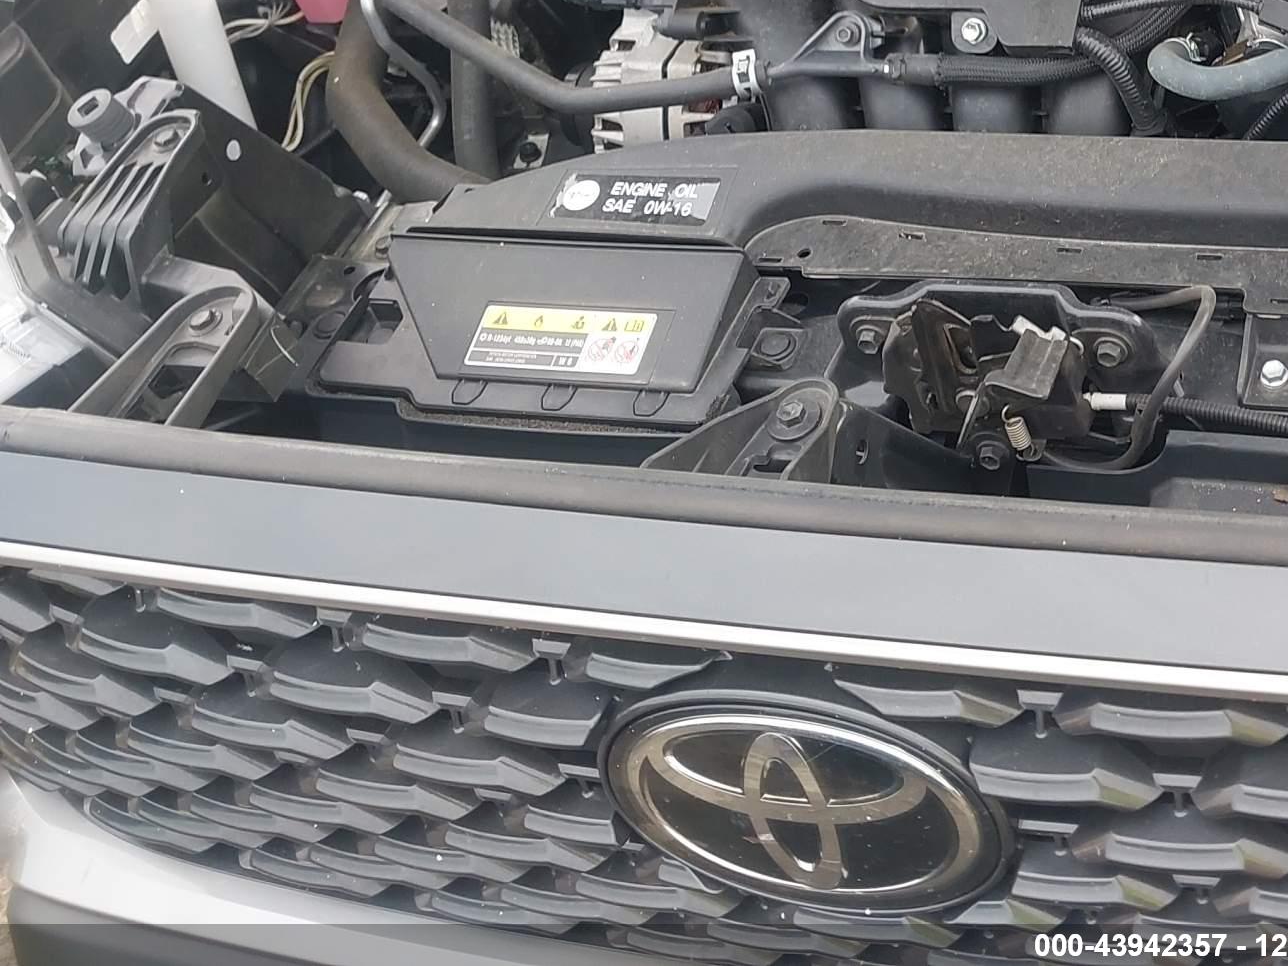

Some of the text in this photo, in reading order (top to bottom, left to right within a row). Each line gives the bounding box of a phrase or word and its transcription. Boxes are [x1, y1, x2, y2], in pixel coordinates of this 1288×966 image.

[610, 181, 667, 198] ENGINE
[674, 183, 698, 199] OIL
[602, 198, 693, 217] SAE 0W-16
